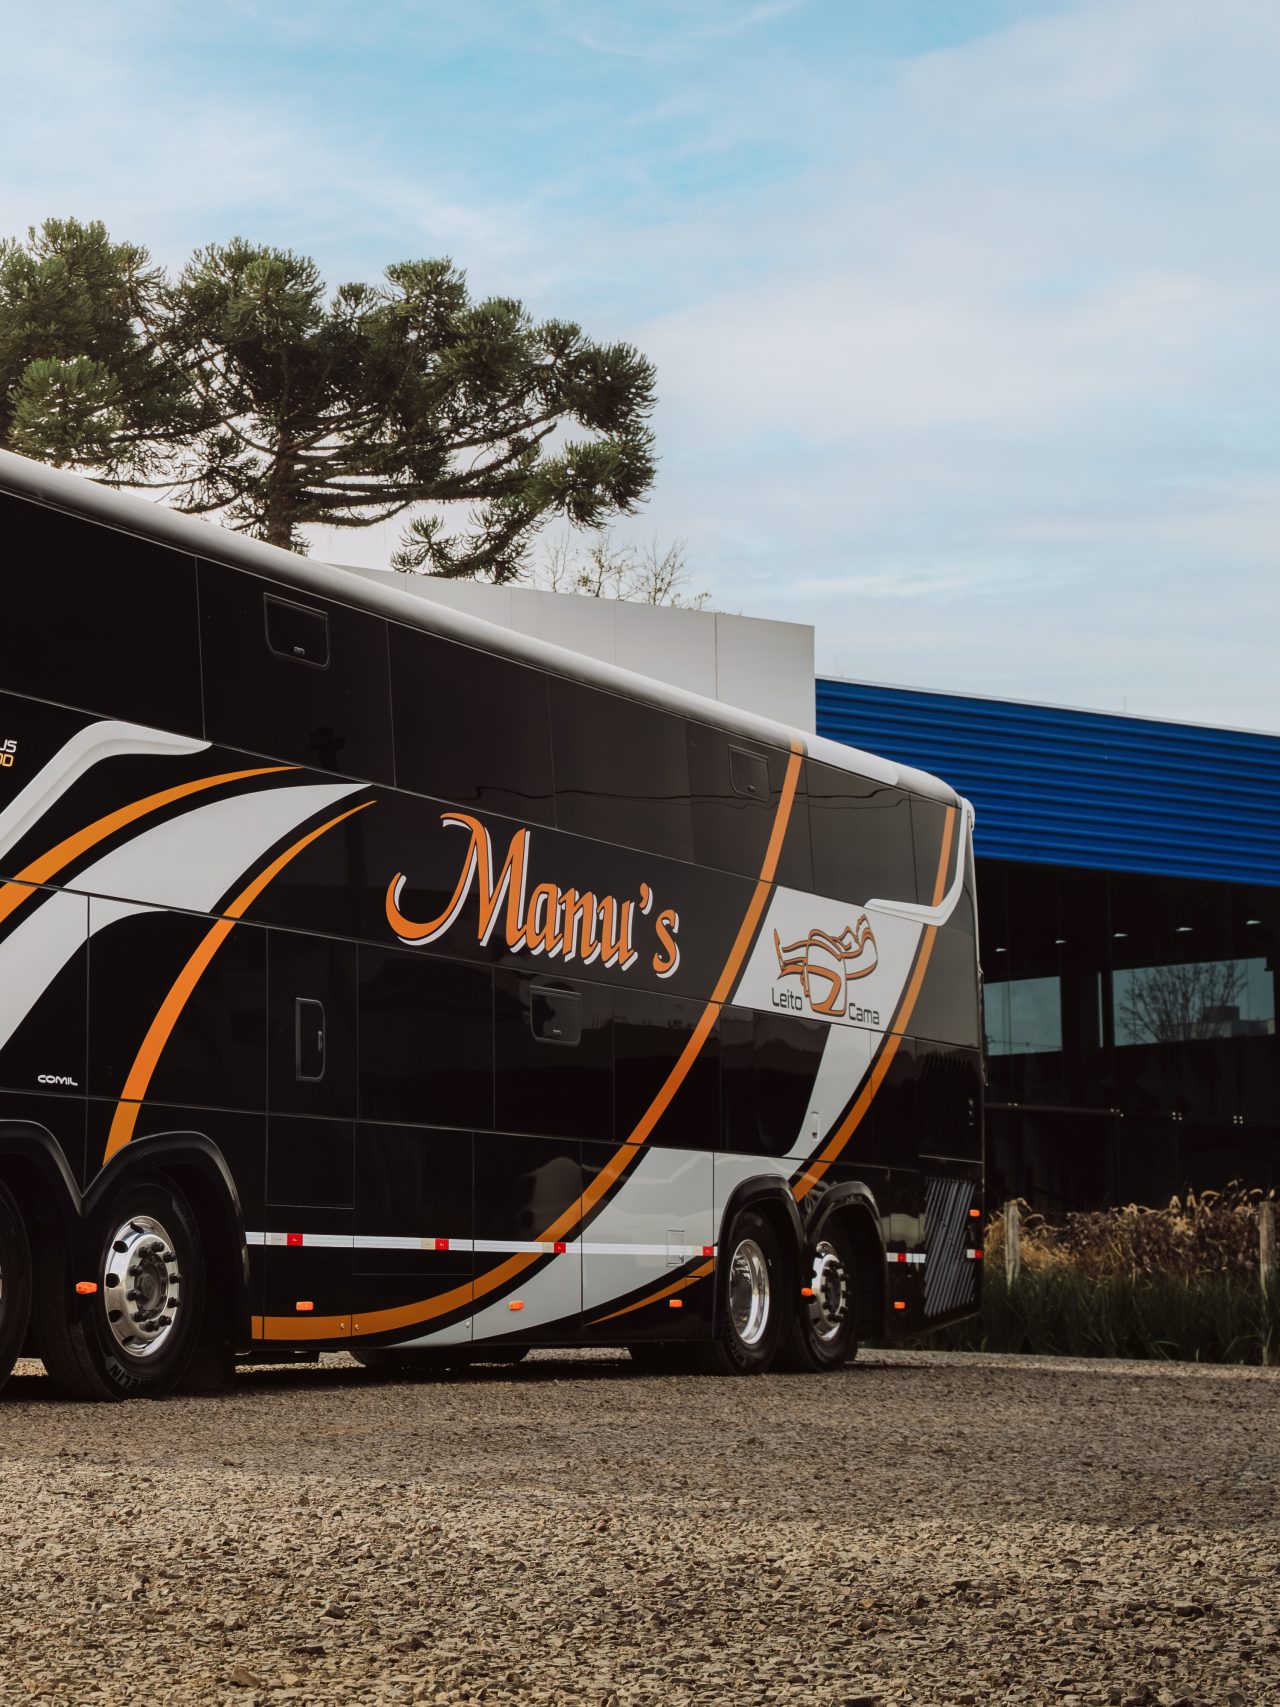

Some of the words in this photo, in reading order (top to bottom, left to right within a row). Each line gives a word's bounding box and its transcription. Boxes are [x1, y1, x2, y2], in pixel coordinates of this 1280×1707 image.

[385, 812, 680, 979] Manu's
[771, 987, 803, 1011] Leito
[848, 1002, 880, 1025] Cama
[37, 1074, 79, 1087] COMIL
